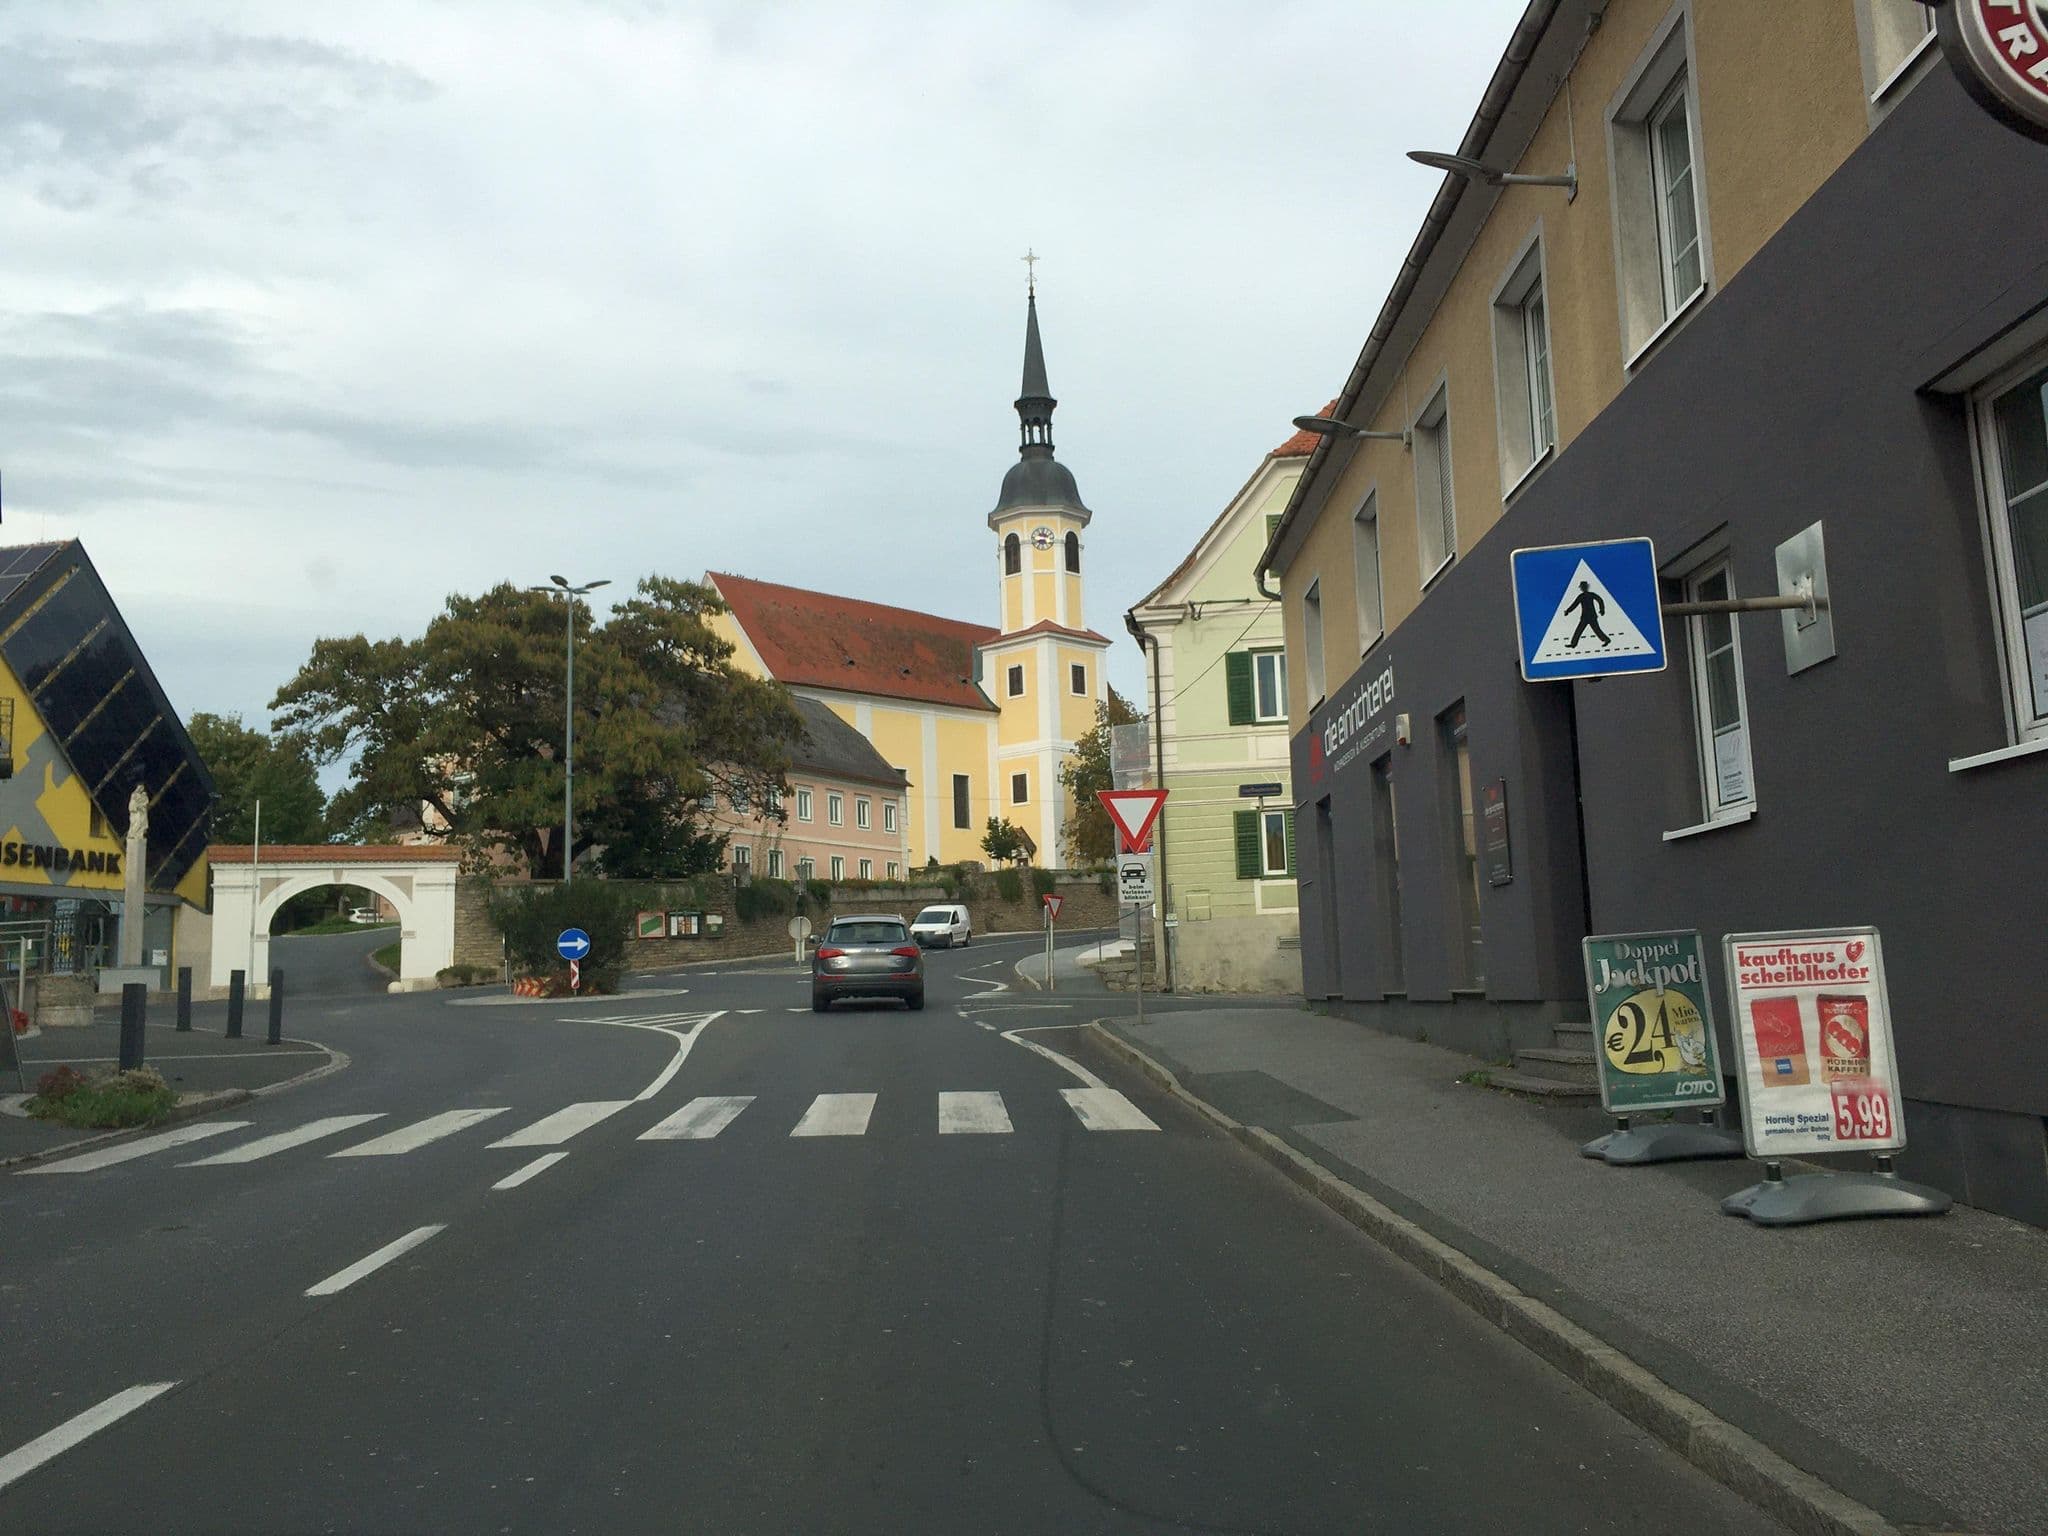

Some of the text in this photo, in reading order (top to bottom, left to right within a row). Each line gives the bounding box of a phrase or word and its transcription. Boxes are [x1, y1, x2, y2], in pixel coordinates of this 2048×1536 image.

[1615, 938, 1680, 963] Doppel
[1738, 948, 1836, 968] kaufhaus
[1595, 954, 1702, 998] Jackpot
[1740, 963, 1869, 985] scheiblhofer
[1675, 1079, 1716, 1096] LOTTO
[1765, 1112, 1829, 1126] Hornig Spezial
[1837, 1094, 1888, 1139] 5.99
